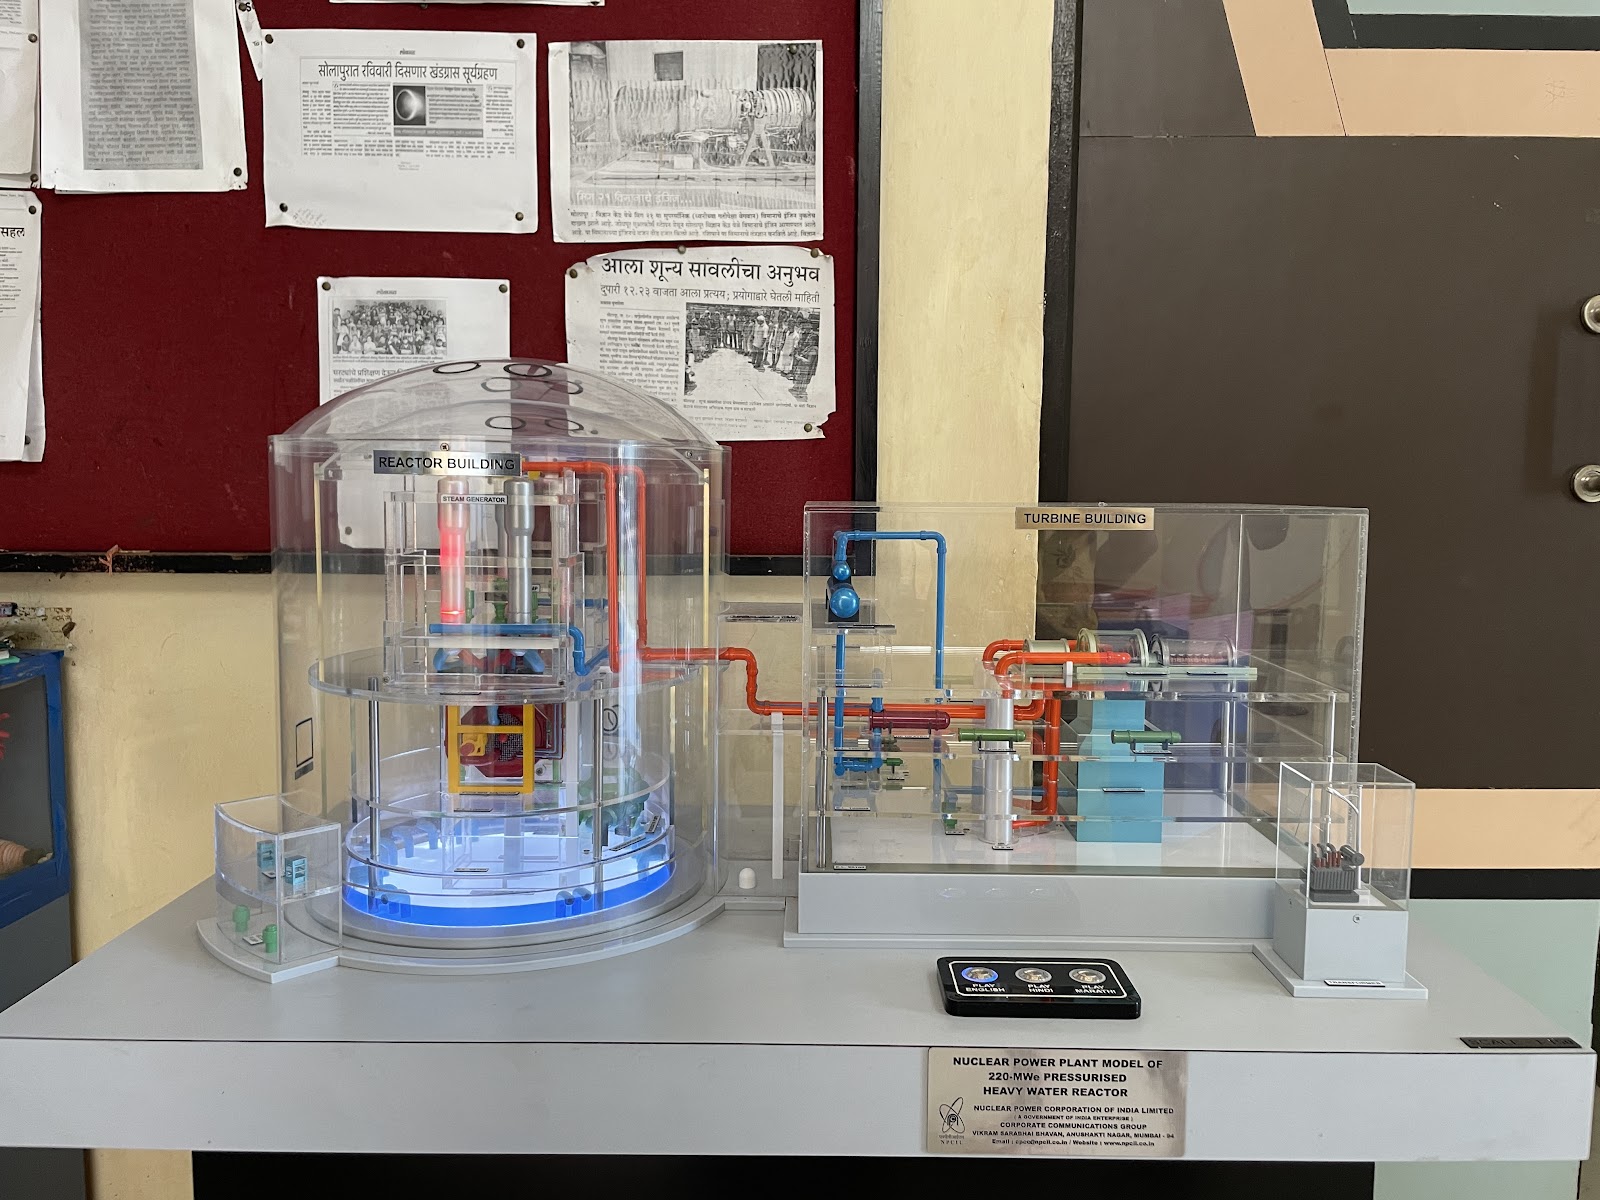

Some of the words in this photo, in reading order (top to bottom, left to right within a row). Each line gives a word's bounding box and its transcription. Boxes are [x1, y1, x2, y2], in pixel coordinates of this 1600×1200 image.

[318, 61, 359, 81] सोलापुरात
[361, 61, 392, 77] रविवारी
[395, 61, 427, 78] दिसणार
[429, 63, 460, 79] खंडग्रास
[462, 63, 497, 83] सूर्यग्रहण
[0, 227, 25, 239] सहल
[601, 258, 644, 275] आला
[649, 260, 683, 282] शून्य
[688, 257, 761, 280] सावलीचा
[767, 265, 820, 287] अनुभव
[600, 283, 620, 296] दुपारी
[624, 286, 650, 297] १२.२३
[652, 287, 677, 297] वाजता
[680, 288, 700, 298] आला
[733, 288, 767, 301] प्रयोगाद्वारे
[770, 290, 792, 301] घेतली
[795, 291, 820, 304] माहिती
[379, 456, 443, 468] REACTOR
[447, 458, 515, 470] BUILDING
[1024, 513, 1081, 524] TURBINE
[1085, 513, 1147, 524] BUILDING
[953, 1057, 1010, 1066] NUCLEAR
[1013, 1058, 1056, 1067] POWER
[1059, 1058, 1098, 1067] PLANT
[1102, 1059, 1144, 1068] MODEL
[1147, 1060, 1163, 1069] OF
[988, 1072, 1040, 1081] 220-MWe
[1044, 1073, 1127, 1082] PRESSURISED
[983, 1086, 1024, 1095] HEAVY
[1026, 1087, 1069, 1096] WATER
[1072, 1087, 1128, 1097] REACTOR
